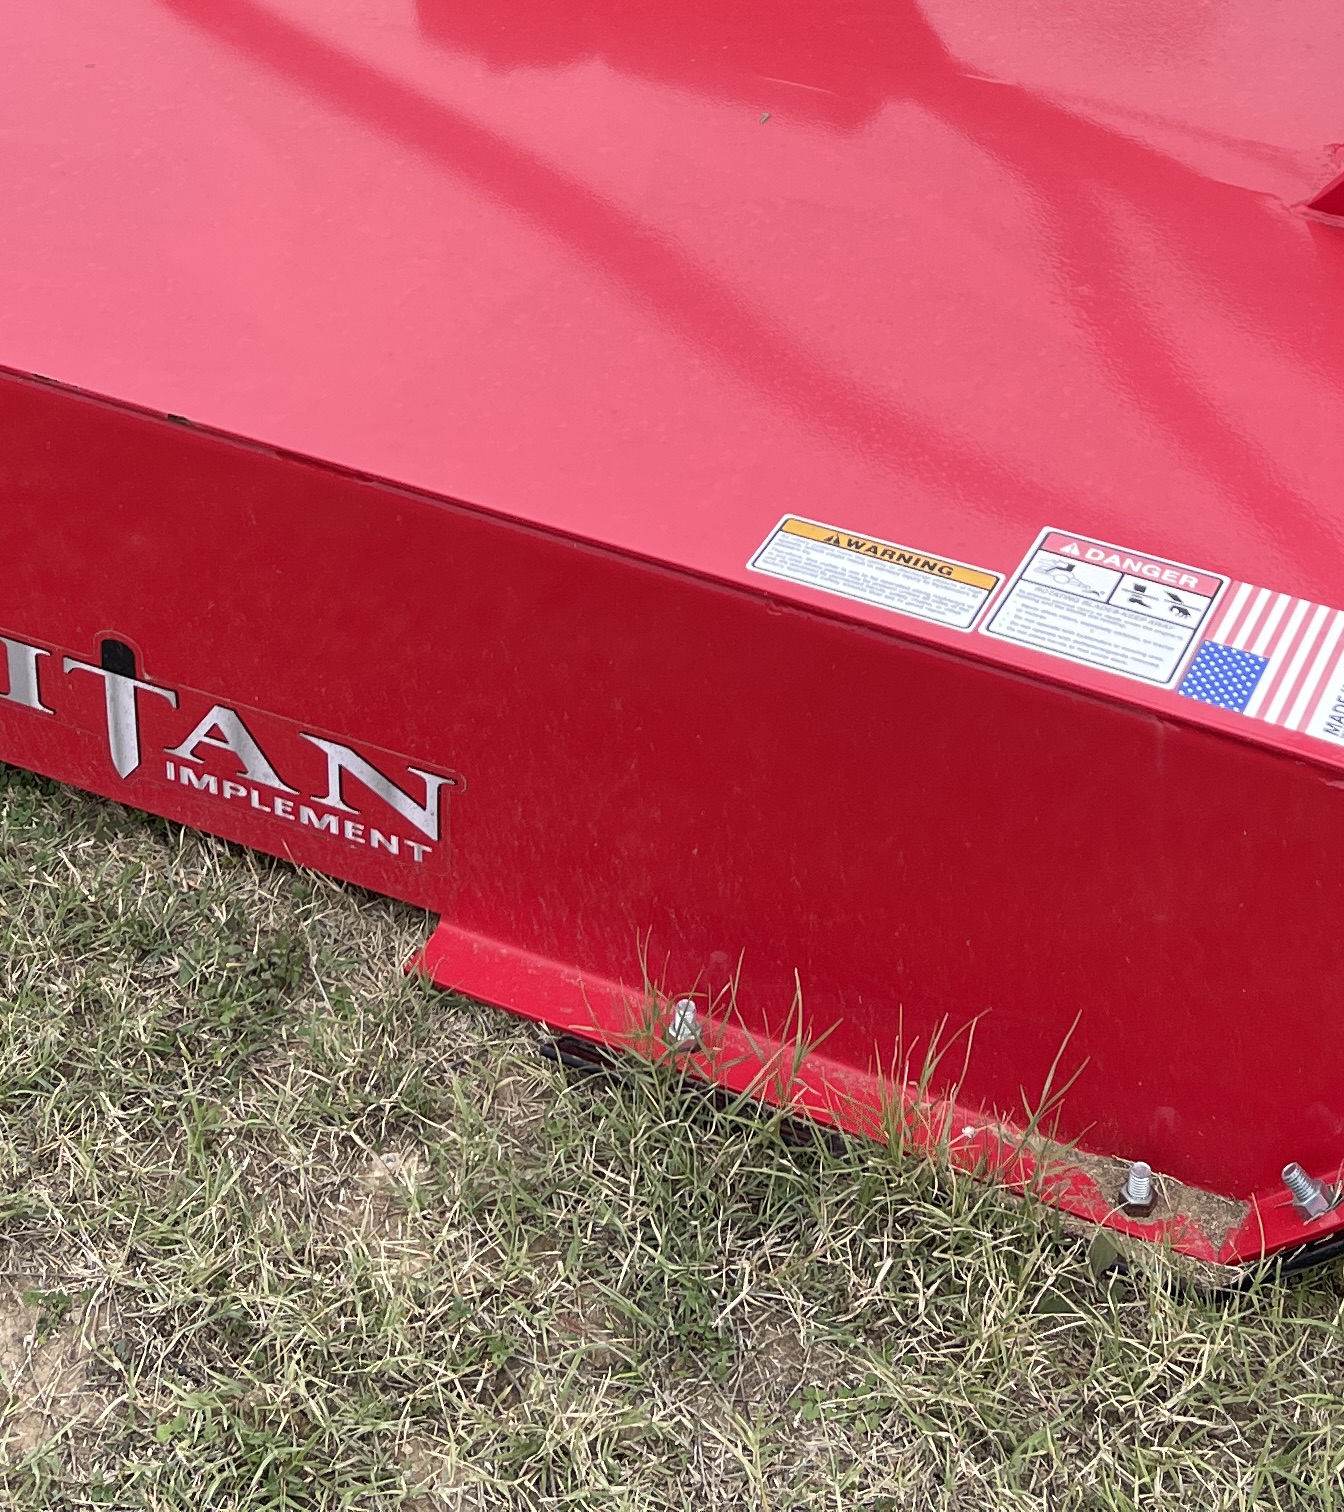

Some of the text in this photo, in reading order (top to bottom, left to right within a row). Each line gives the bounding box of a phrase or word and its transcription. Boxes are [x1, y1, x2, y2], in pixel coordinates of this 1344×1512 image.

[846, 537, 955, 577] WARNING
[1084, 547, 1200, 589] DANGER
[164, 761, 434, 864] IMPLEMENT
